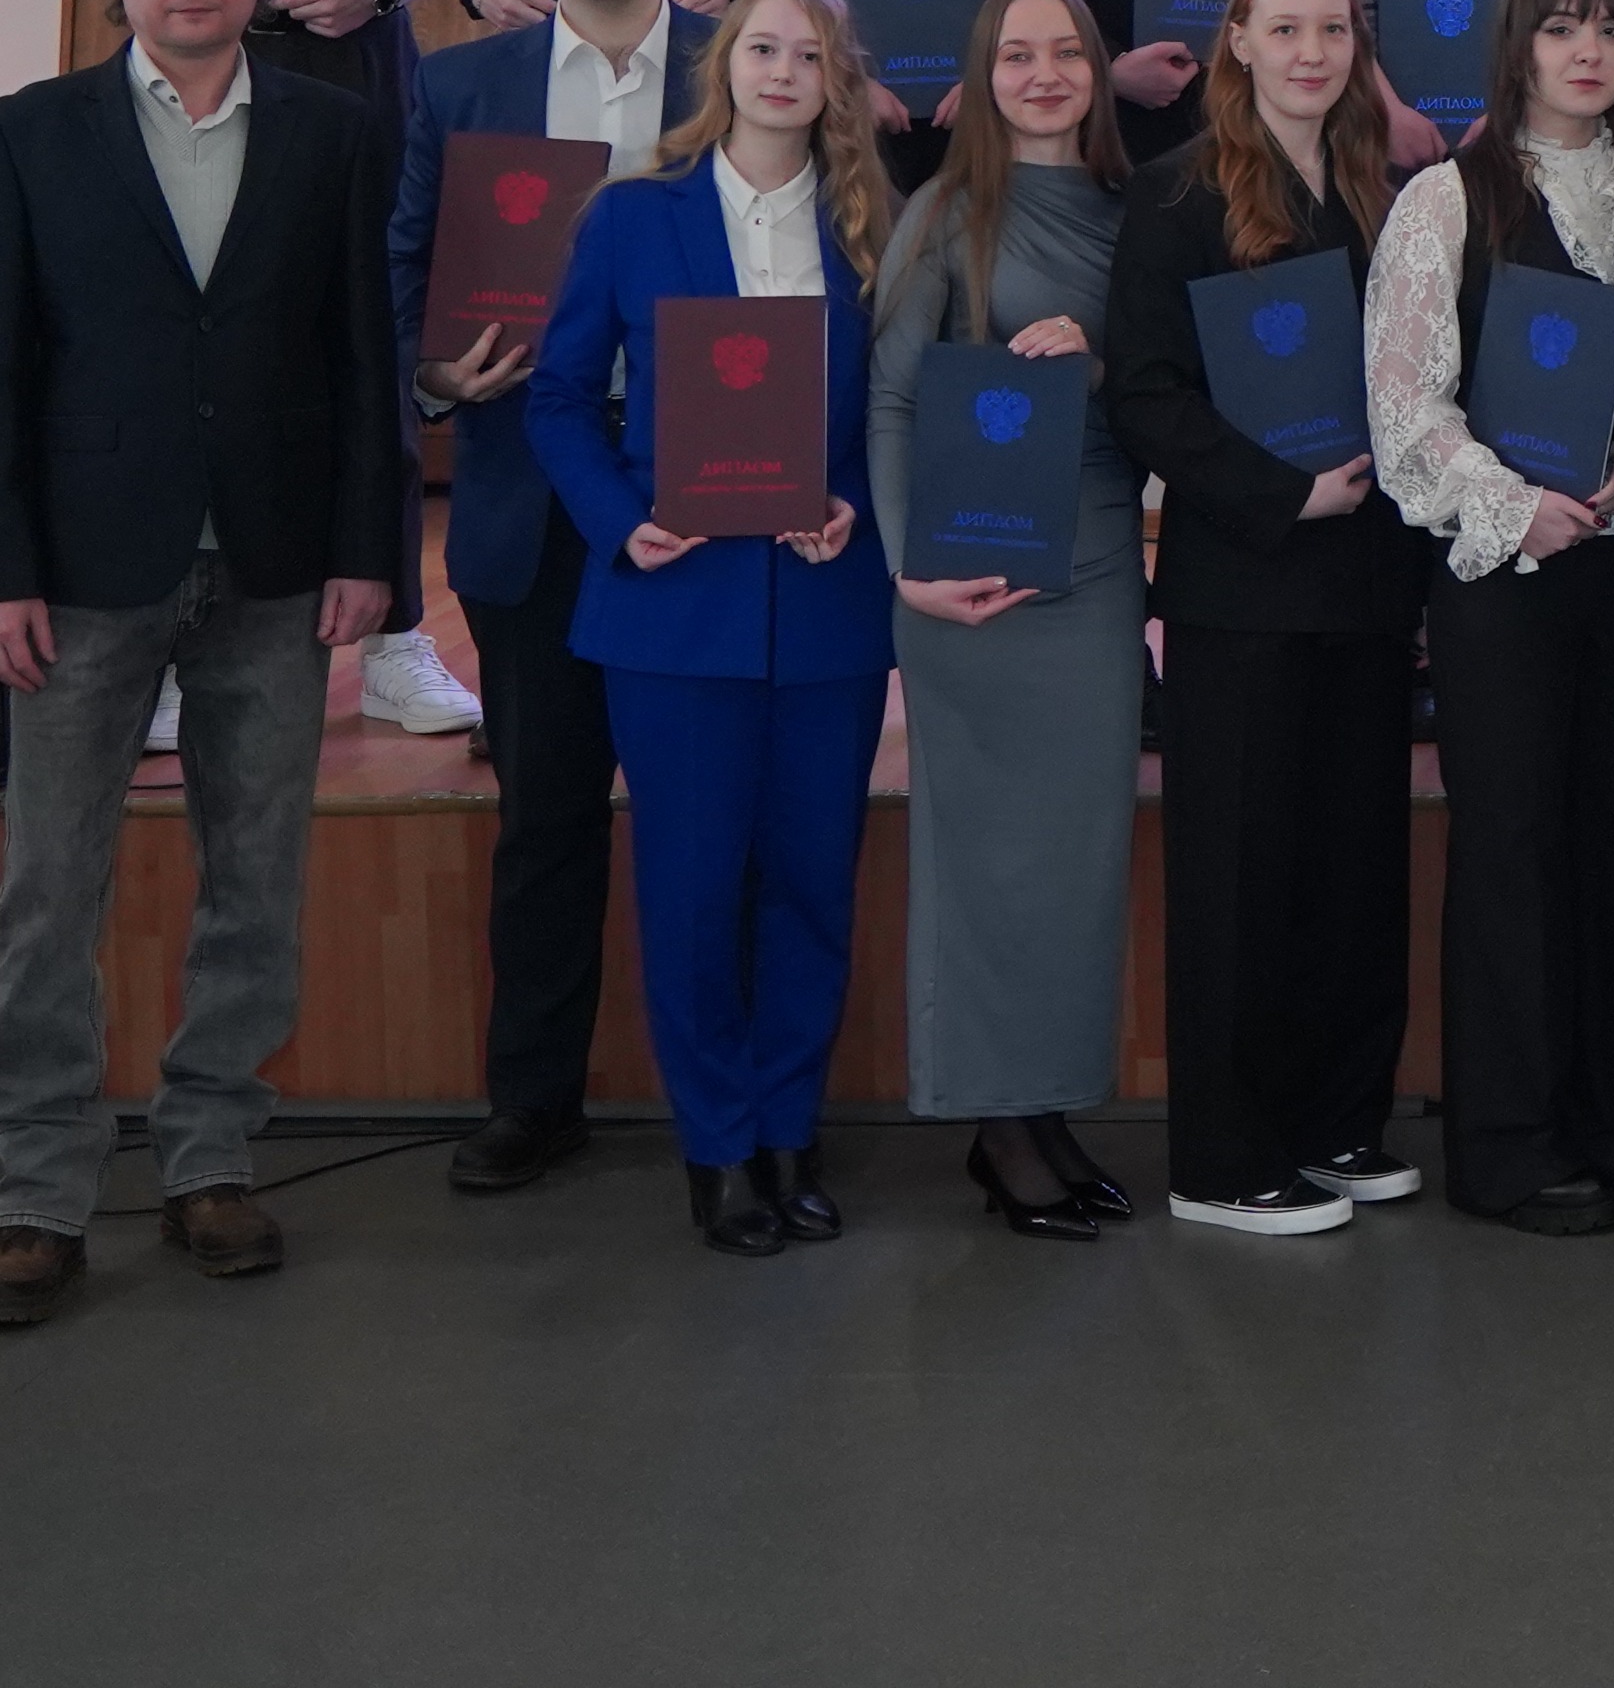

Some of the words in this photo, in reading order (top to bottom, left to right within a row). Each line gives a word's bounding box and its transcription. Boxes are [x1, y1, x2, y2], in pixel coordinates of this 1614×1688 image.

[885, 55, 957, 71] ДИПЛОМ
[1415, 96, 1486, 111] ДИПЛОМ
[1264, 416, 1341, 446] ДИПЛОМ
[1498, 431, 1569, 458] ДИПЛОМ
[954, 511, 1034, 531] ДИПЛОМ
